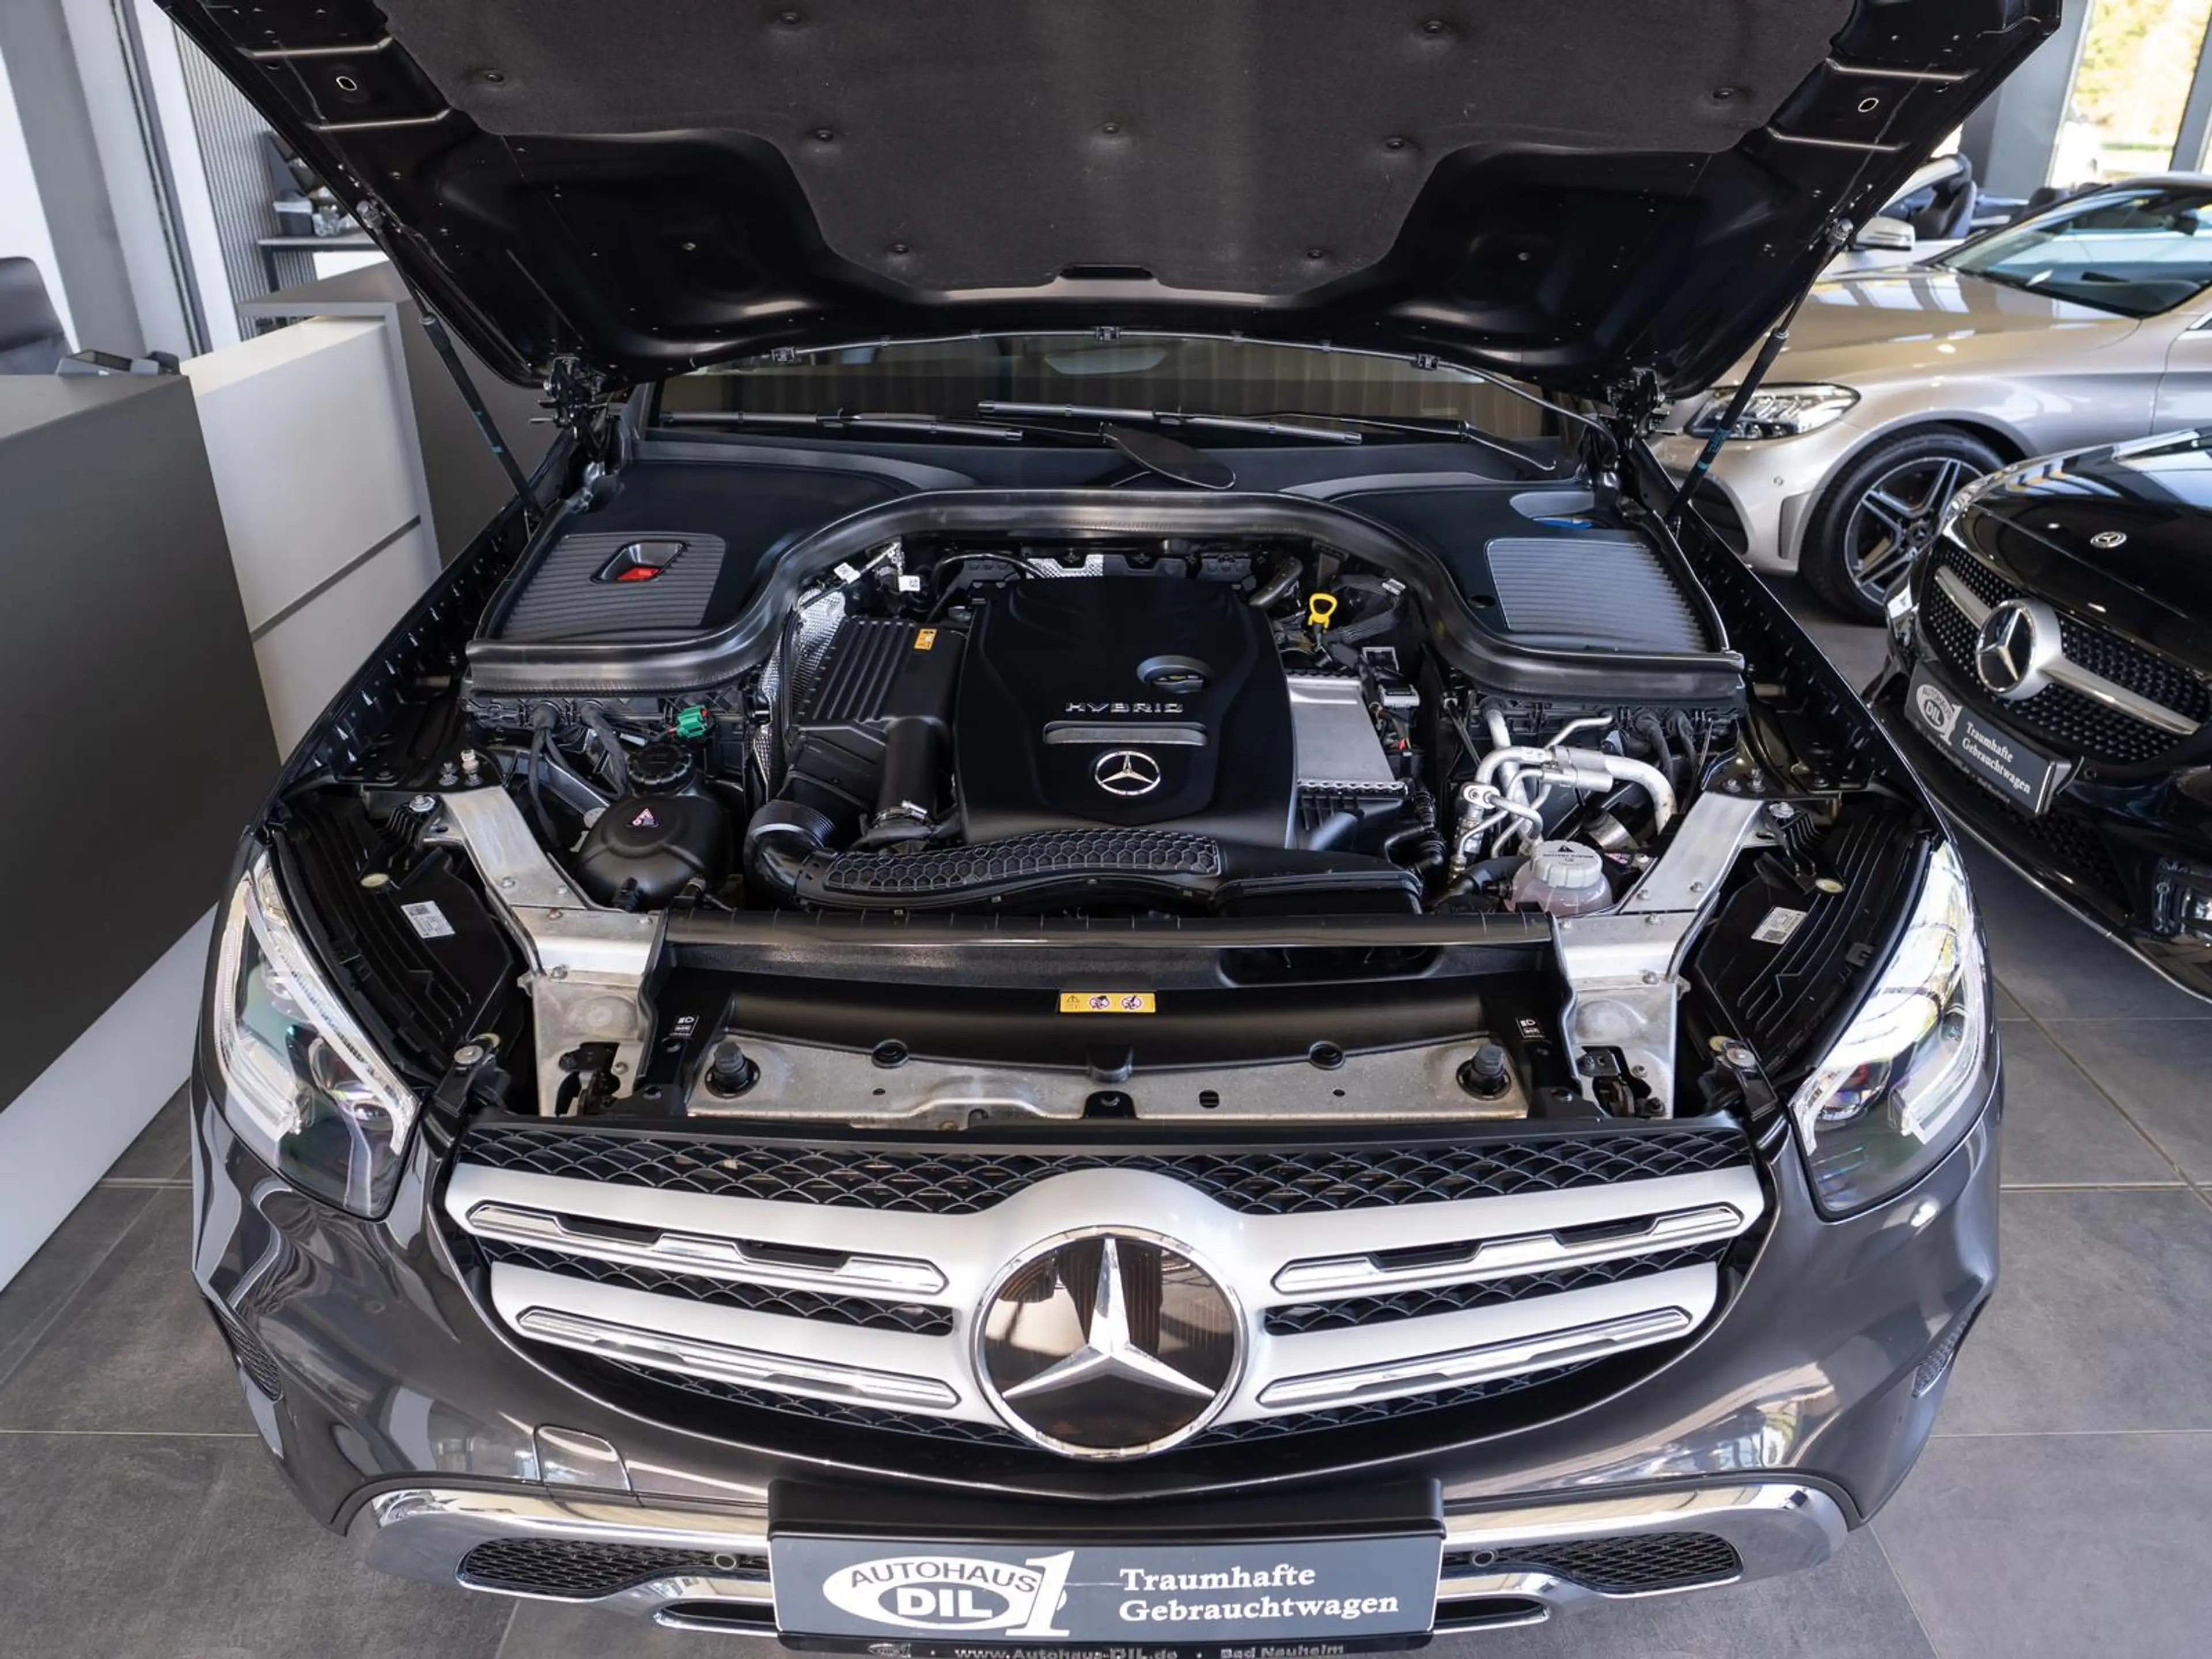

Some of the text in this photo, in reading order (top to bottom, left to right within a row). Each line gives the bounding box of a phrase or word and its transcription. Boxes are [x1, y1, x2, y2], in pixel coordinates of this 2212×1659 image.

[850, 1561, 1038, 1593] AUTOHAUS
[1119, 1563, 1316, 1592] Traumhafte
[896, 1587, 993, 1619] DIL
[1119, 1595, 1399, 1622] Gebrauchtwagen
